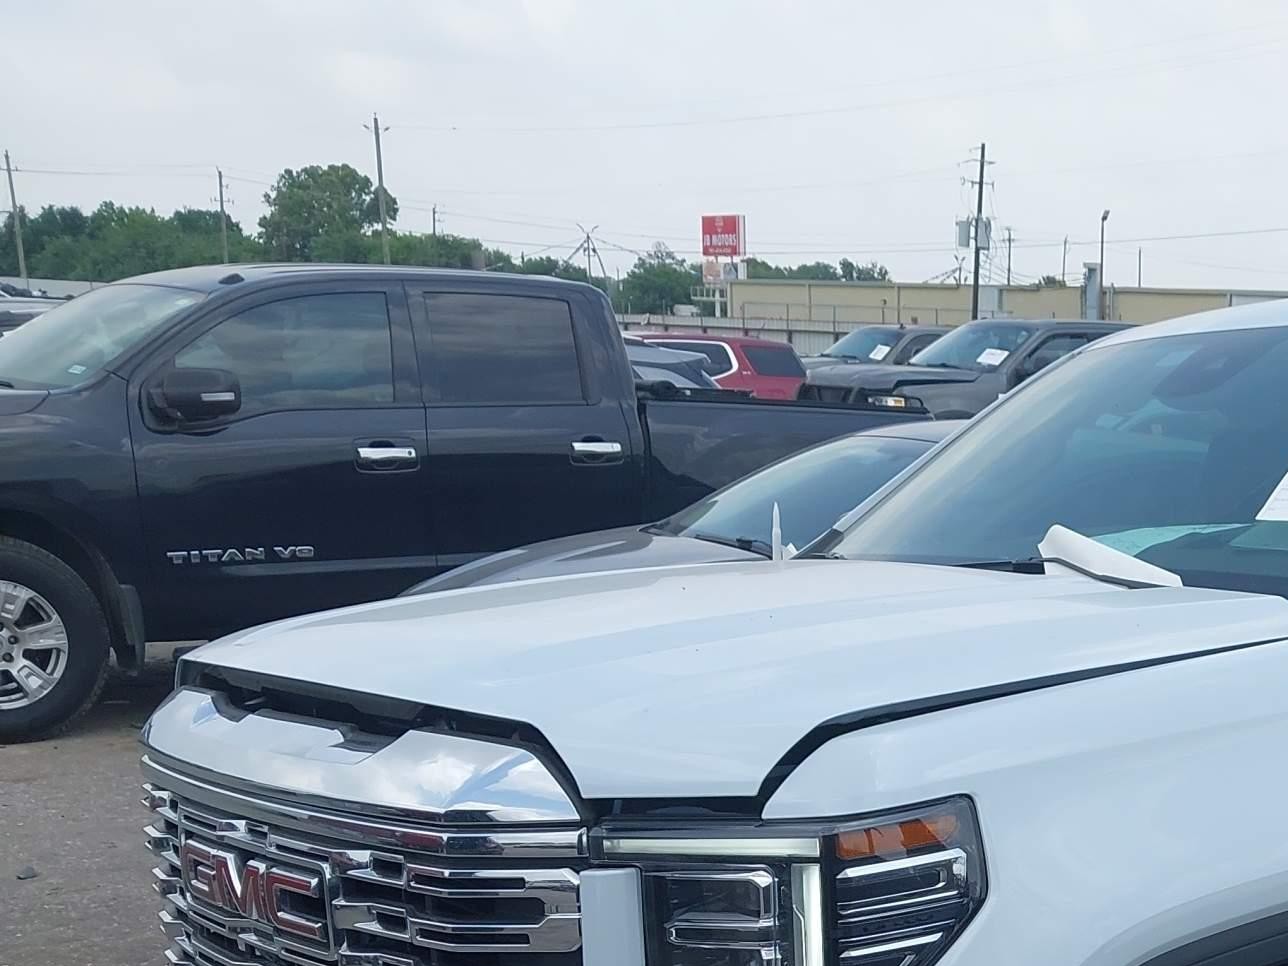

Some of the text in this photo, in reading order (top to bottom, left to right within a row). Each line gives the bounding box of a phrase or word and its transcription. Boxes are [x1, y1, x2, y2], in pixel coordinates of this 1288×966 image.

[712, 233, 736, 246] MOTORS
[166, 546, 314, 564] TITAN V8
[182, 839, 328, 943] GMC
